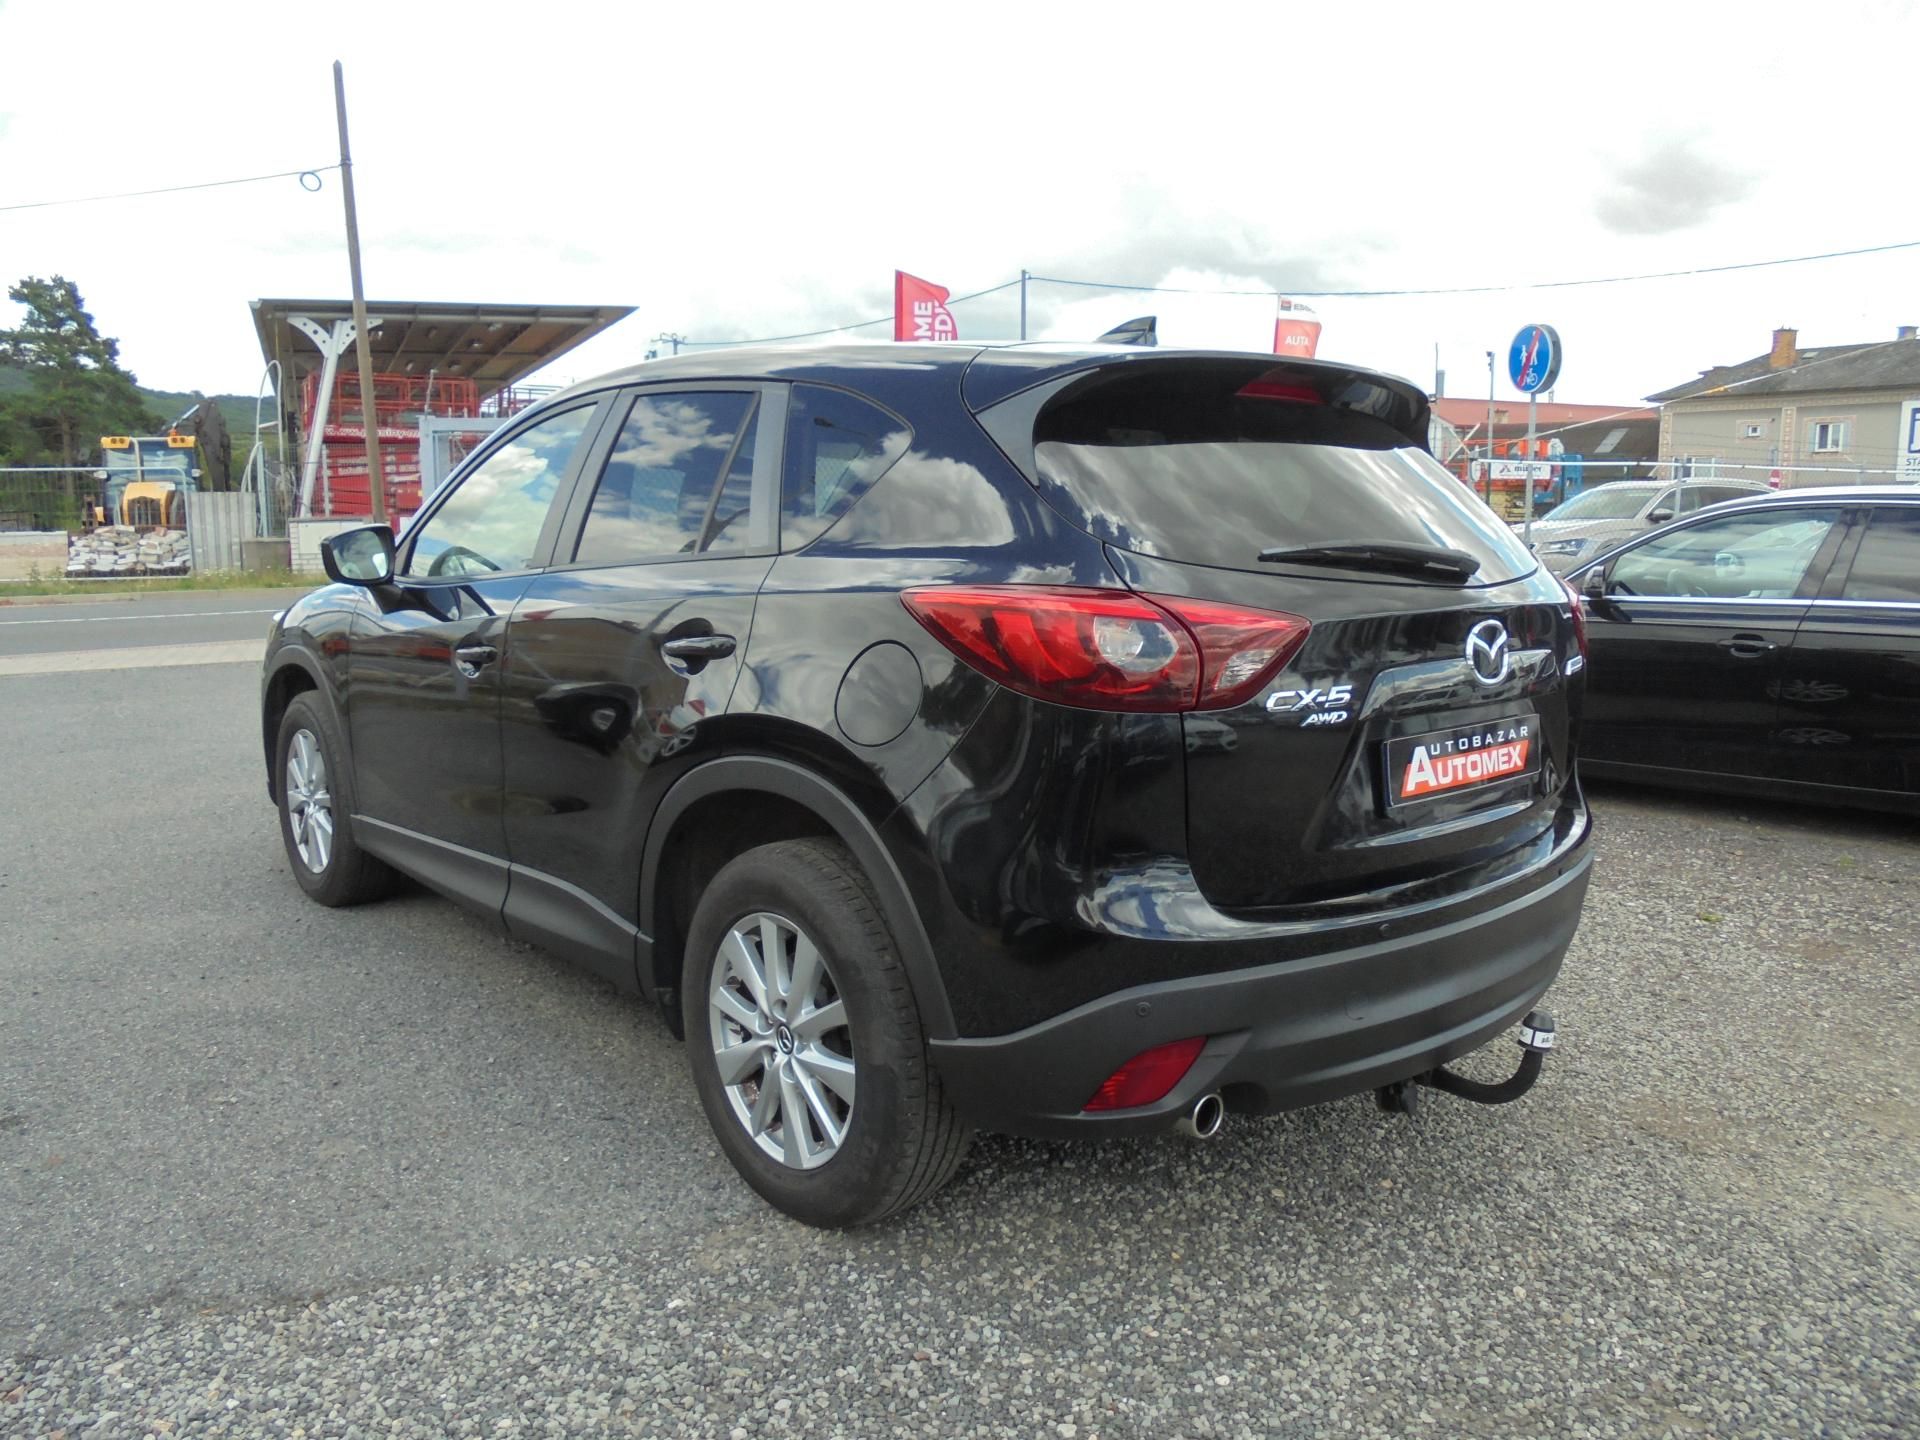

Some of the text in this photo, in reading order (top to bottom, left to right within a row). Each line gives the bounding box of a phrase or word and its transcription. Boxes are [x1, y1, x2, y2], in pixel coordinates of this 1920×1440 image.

[1266, 685, 1352, 713] CX-5
[1301, 711, 1347, 727] AWD
[1406, 744, 1522, 792] AUTOMEX
